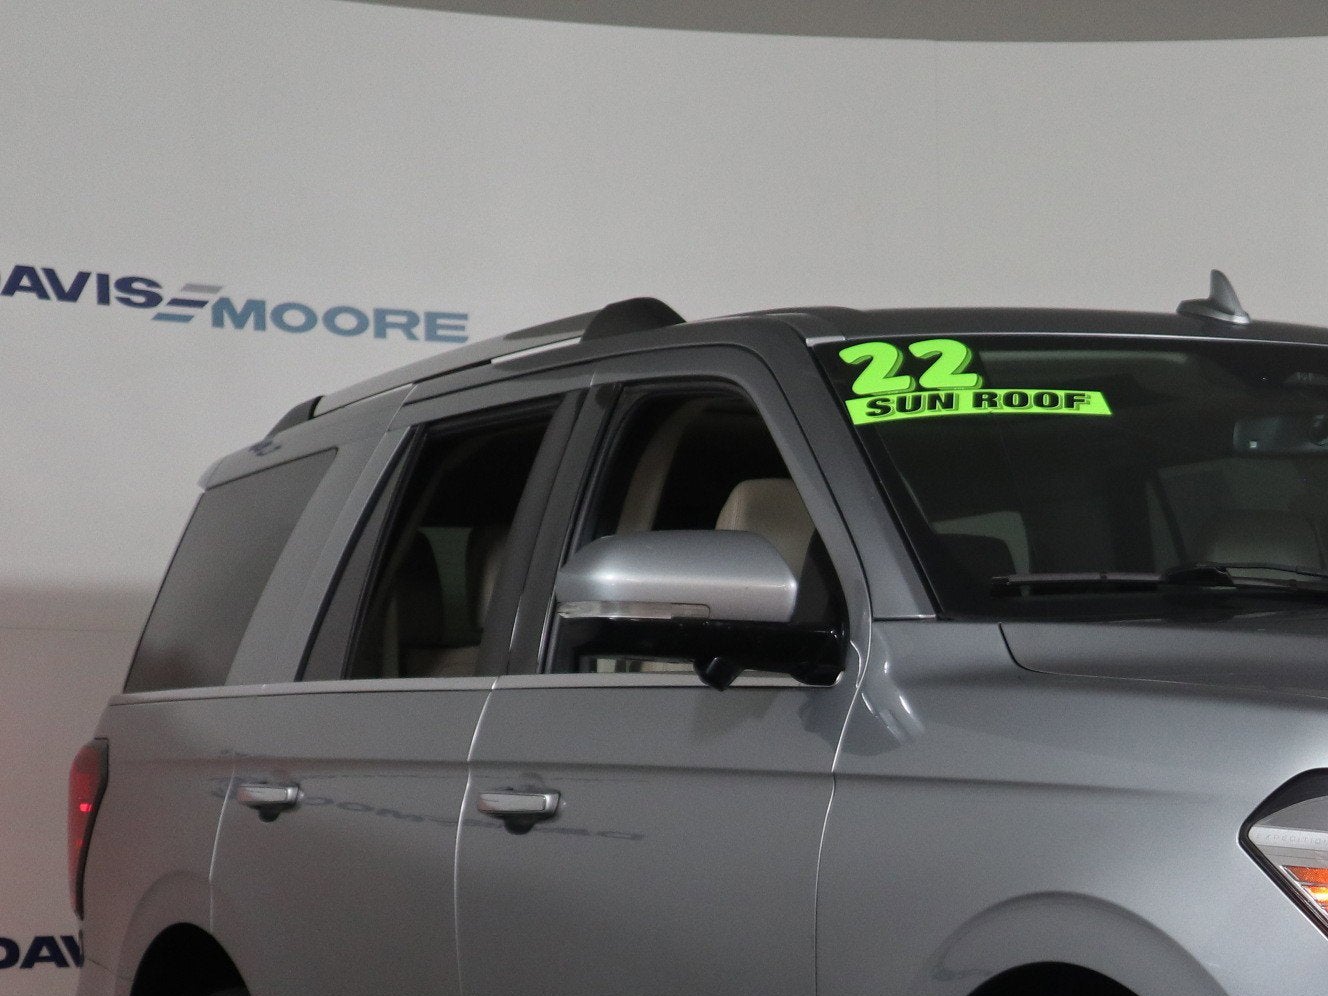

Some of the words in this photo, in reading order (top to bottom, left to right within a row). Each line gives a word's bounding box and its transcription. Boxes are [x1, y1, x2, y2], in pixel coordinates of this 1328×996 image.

[0, 264, 163, 310] AVIS
[212, 296, 469, 344] MOORE
[838, 338, 984, 396] 22
[865, 392, 959, 418] SUN
[971, 390, 1090, 411] ROOF
